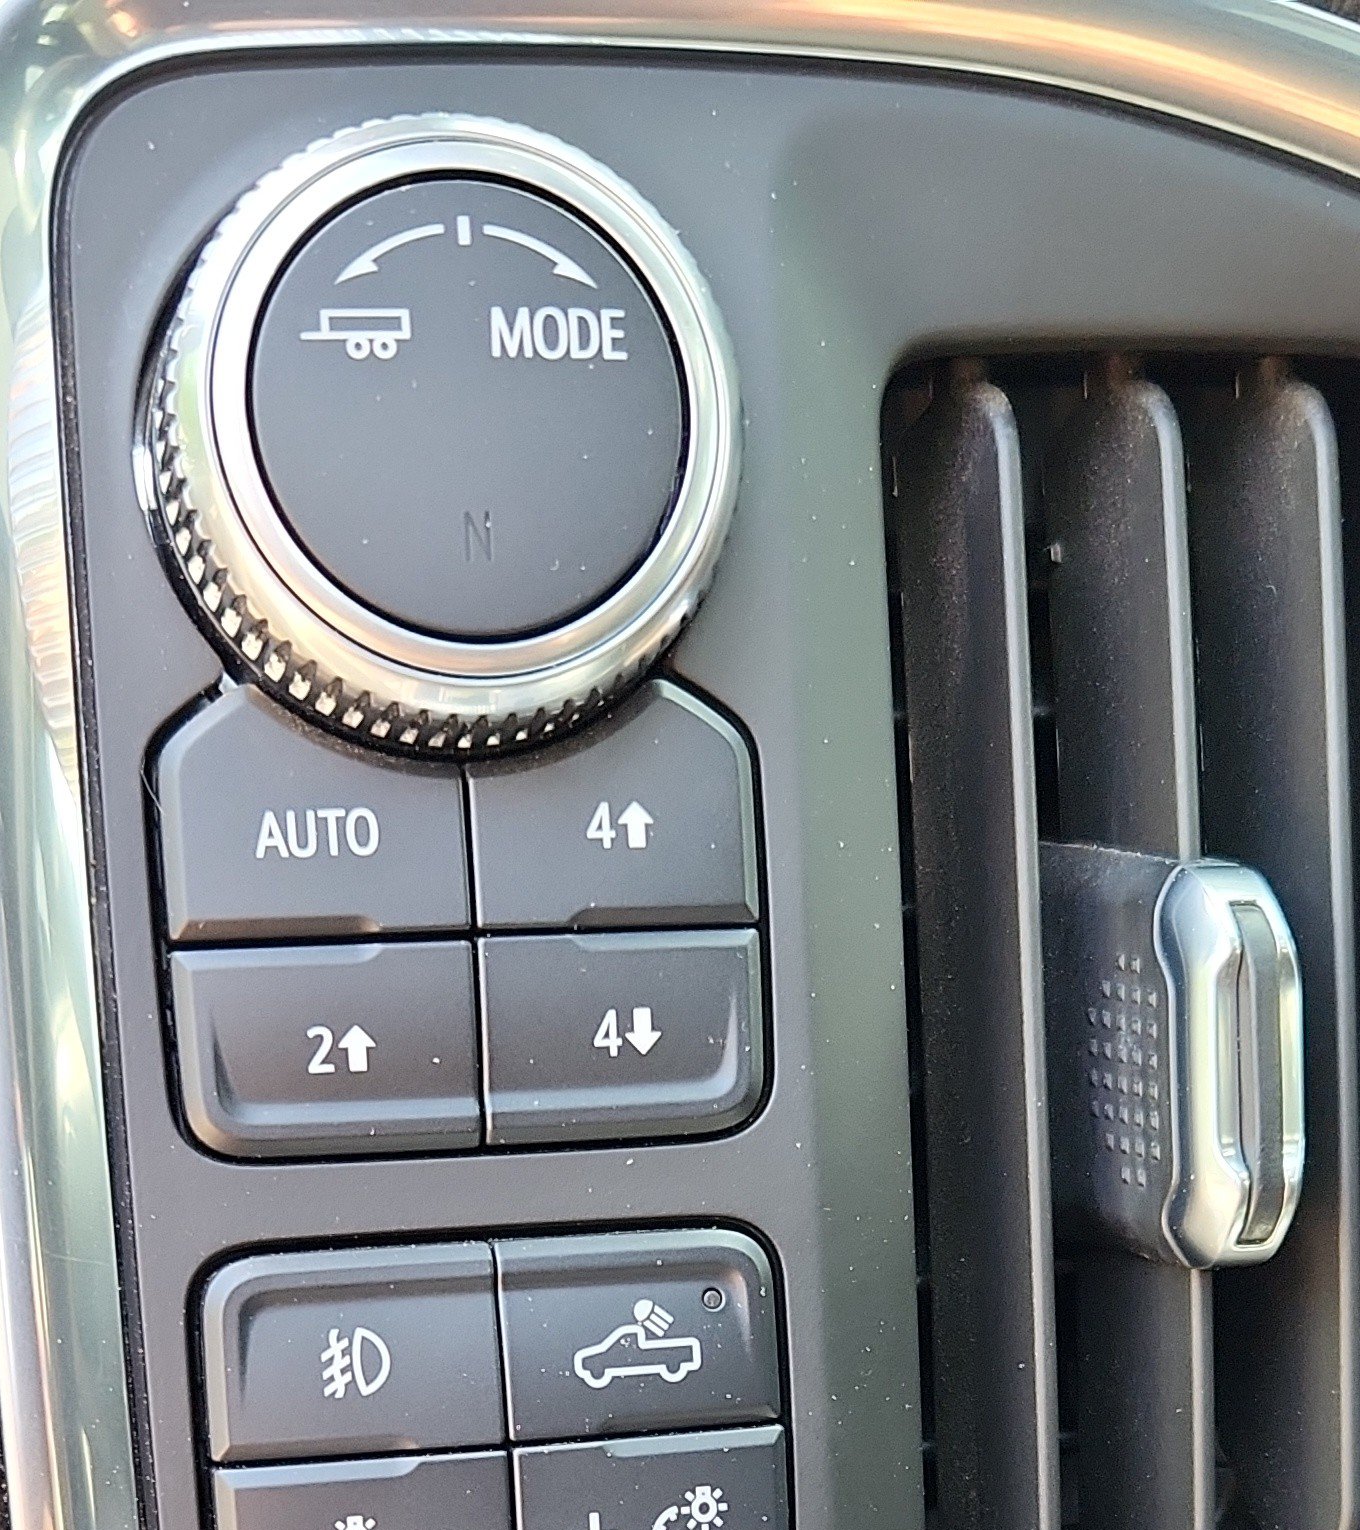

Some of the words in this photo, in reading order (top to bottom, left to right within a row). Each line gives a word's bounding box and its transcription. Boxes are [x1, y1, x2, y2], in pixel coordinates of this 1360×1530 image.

[490, 306, 628, 361] MODE
[254, 806, 381, 860] AUTO
[586, 801, 617, 850] 4
[306, 1025, 336, 1075] 2
[592, 1008, 624, 1058] 4
